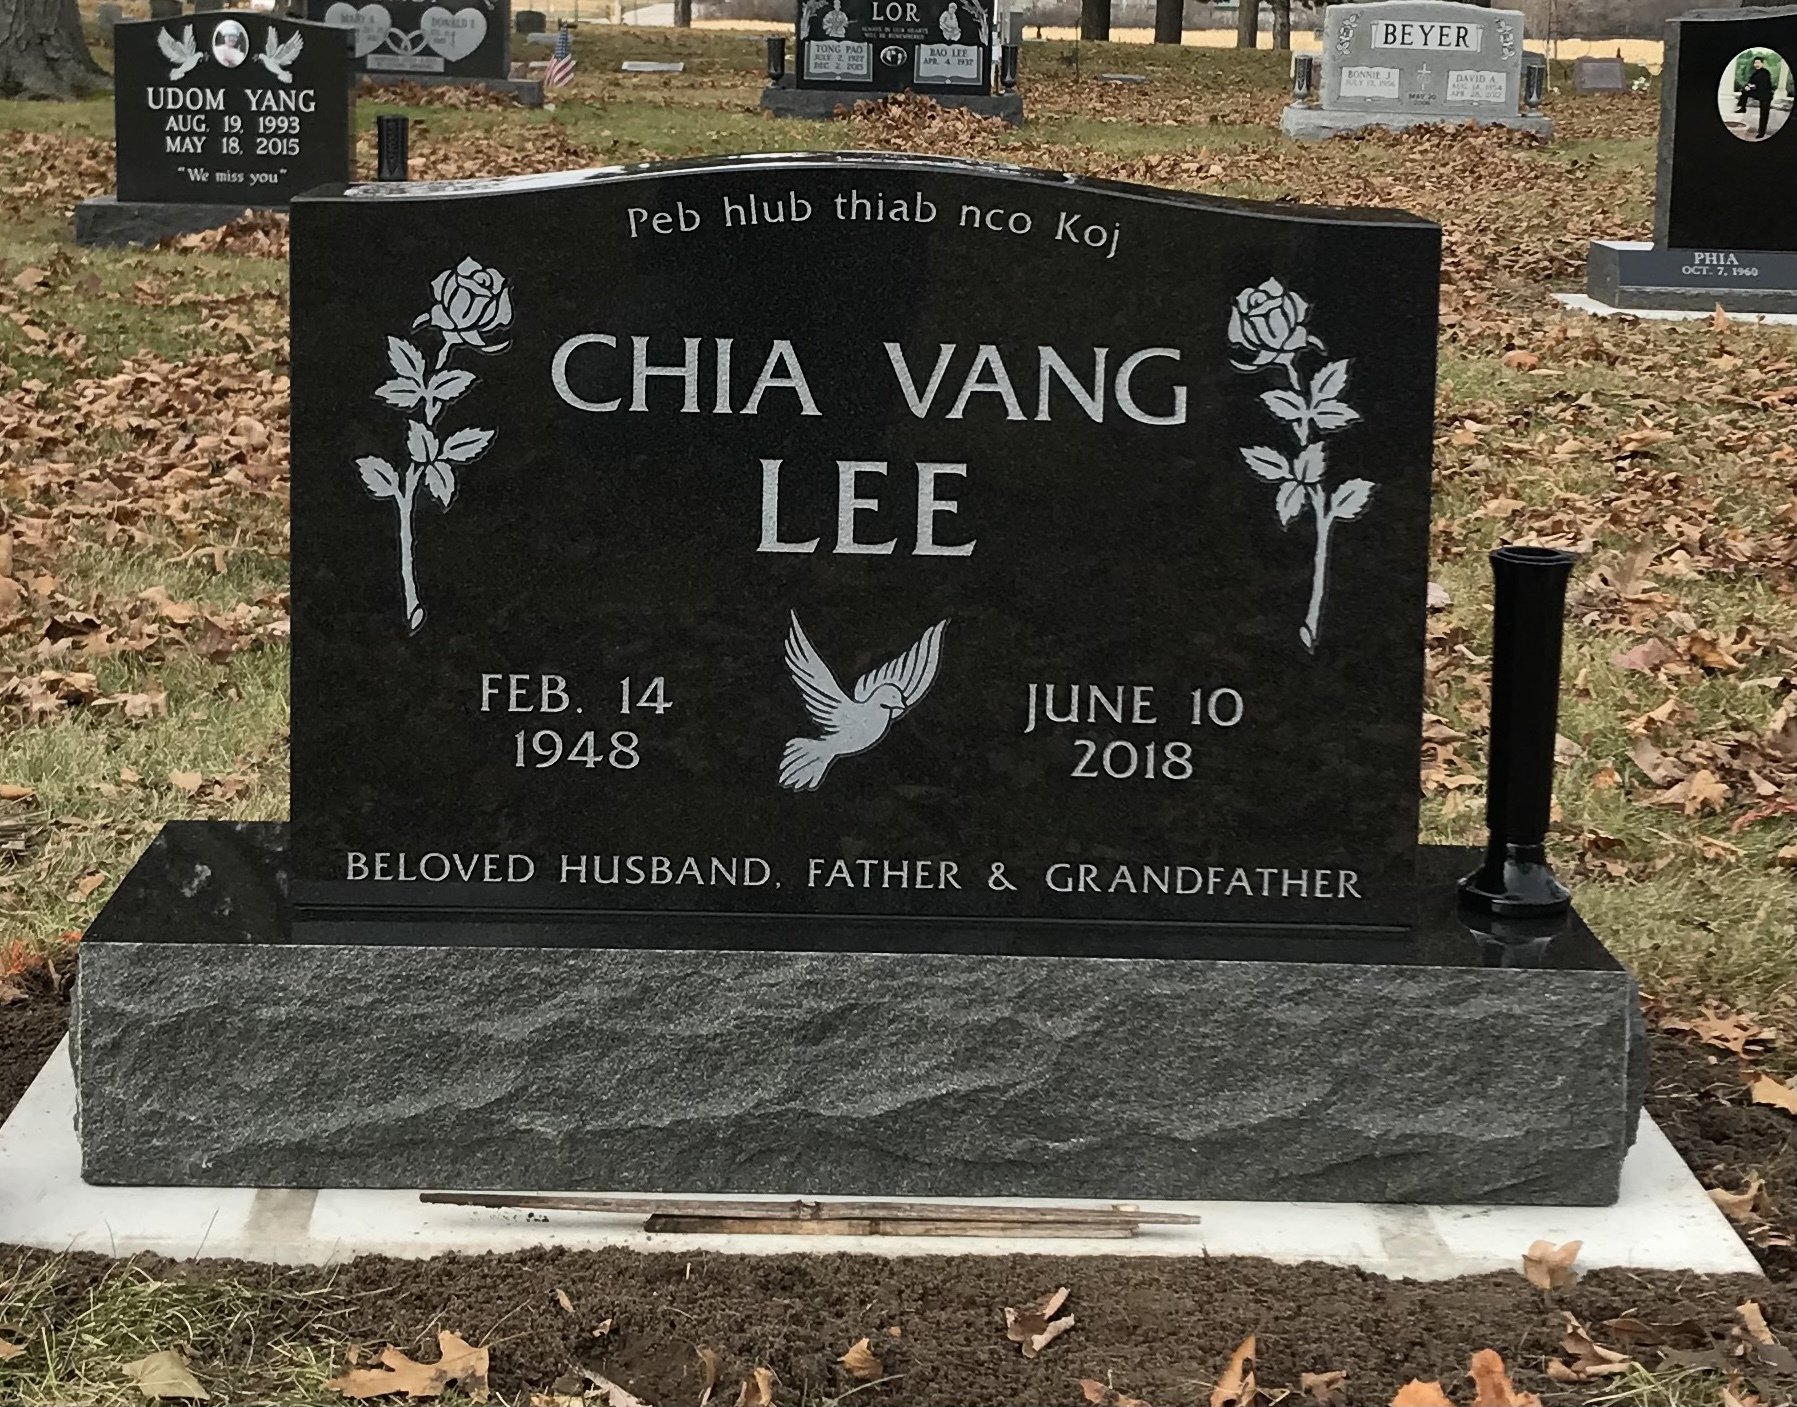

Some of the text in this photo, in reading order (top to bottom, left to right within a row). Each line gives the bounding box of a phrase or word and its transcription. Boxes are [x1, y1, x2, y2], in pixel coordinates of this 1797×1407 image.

[872, 1, 921, 22] LOR
[1383, 23, 1470, 48] BEYER
[815, 44, 863, 54] TONG PAO
[929, 48, 968, 58] BAO LEE
[1347, 70, 1381, 79] BONNIE
[1456, 74, 1486, 83] DAVID
[146, 86, 316, 113] UDOM YANG
[165, 114, 210, 133] AUG.
[258, 116, 300, 135] 1993
[165, 136, 207, 153] MAY
[256, 138, 300, 156] 2015
[177, 166, 288, 186] "We miss you"
[627, 189, 1121, 259] Peb hlub thiab nco Koj
[1693, 251, 1740, 265] PHIA
[1681, 265, 1714, 276] OCT.
[1732, 267, 1759, 277] 1960
[551, 333, 1188, 426] CHIA VANG
[755, 458, 977, 557] LEE
[480, 673, 674, 715] FEB. 14
[1023, 683, 1244, 734] JUNE 10
[514, 729, 640, 770] 1948
[1070, 739, 1193, 780] 2018
[346, 852, 1362, 899] BELOVED HUSBAND, FATHER & GRANDFATHER
